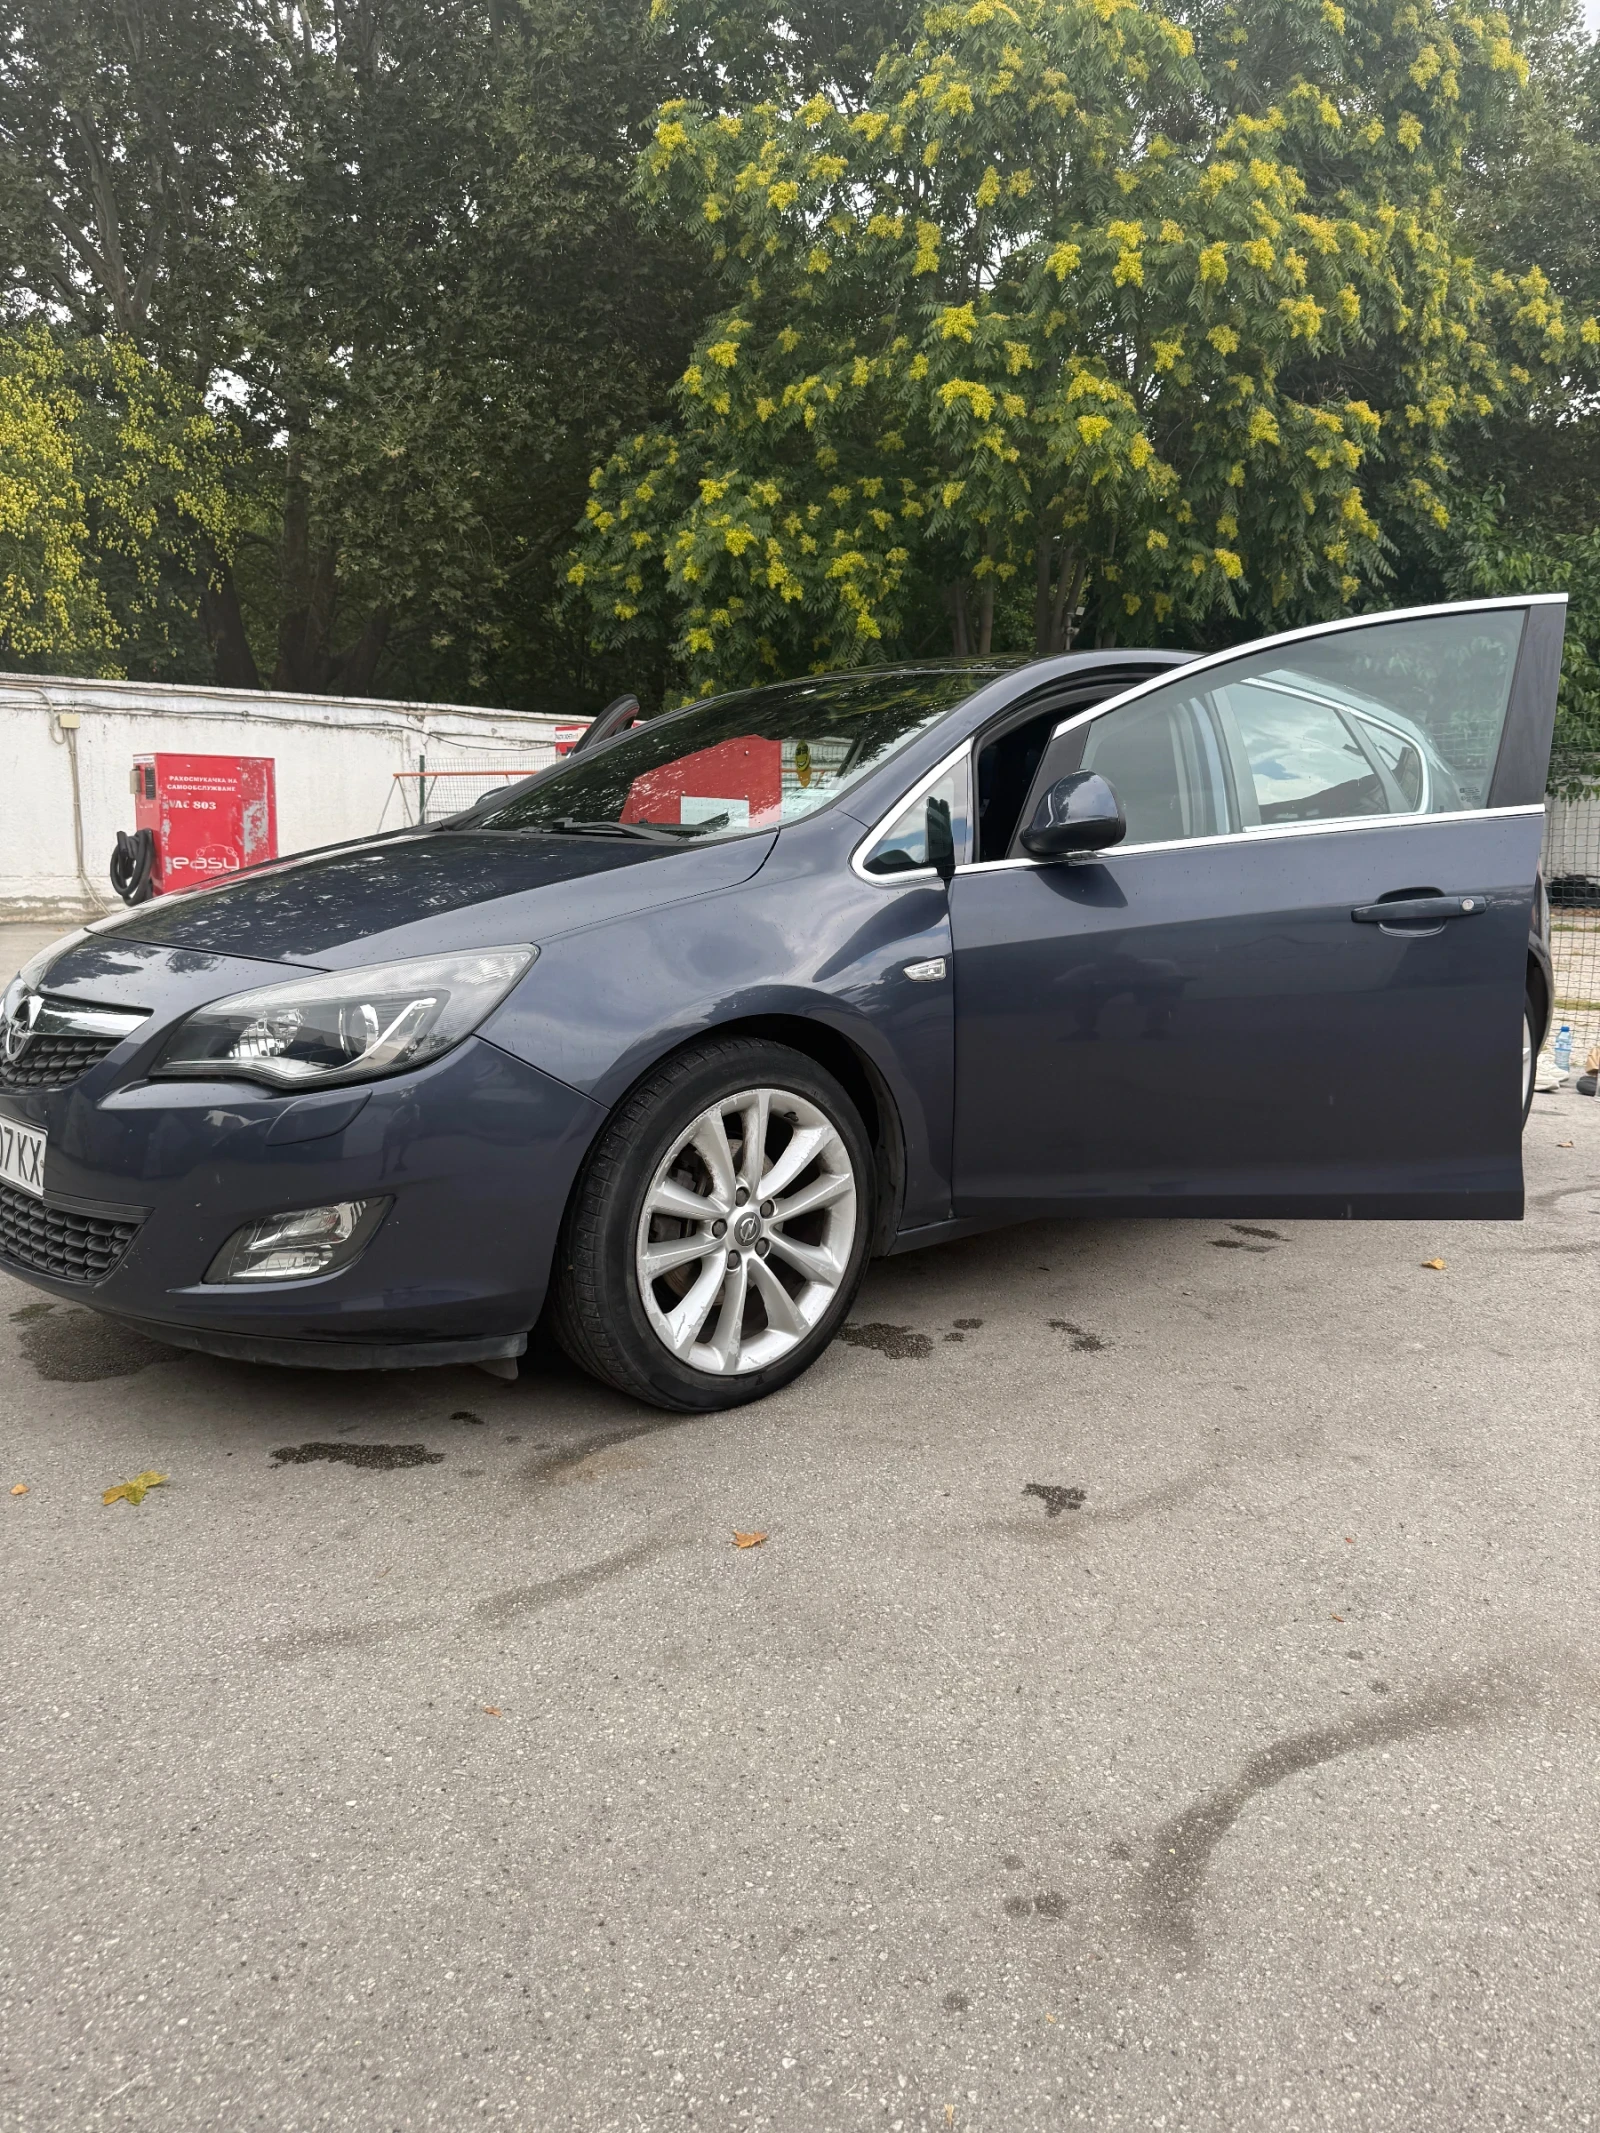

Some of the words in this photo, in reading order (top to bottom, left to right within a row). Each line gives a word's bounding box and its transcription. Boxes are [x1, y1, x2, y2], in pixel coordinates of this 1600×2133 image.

[167, 784, 236, 792] САМООБСЛУЖВАНЕ
[169, 800, 190, 809] VAC
[193, 801, 217, 810] 803
[172, 856, 240, 870] easy
